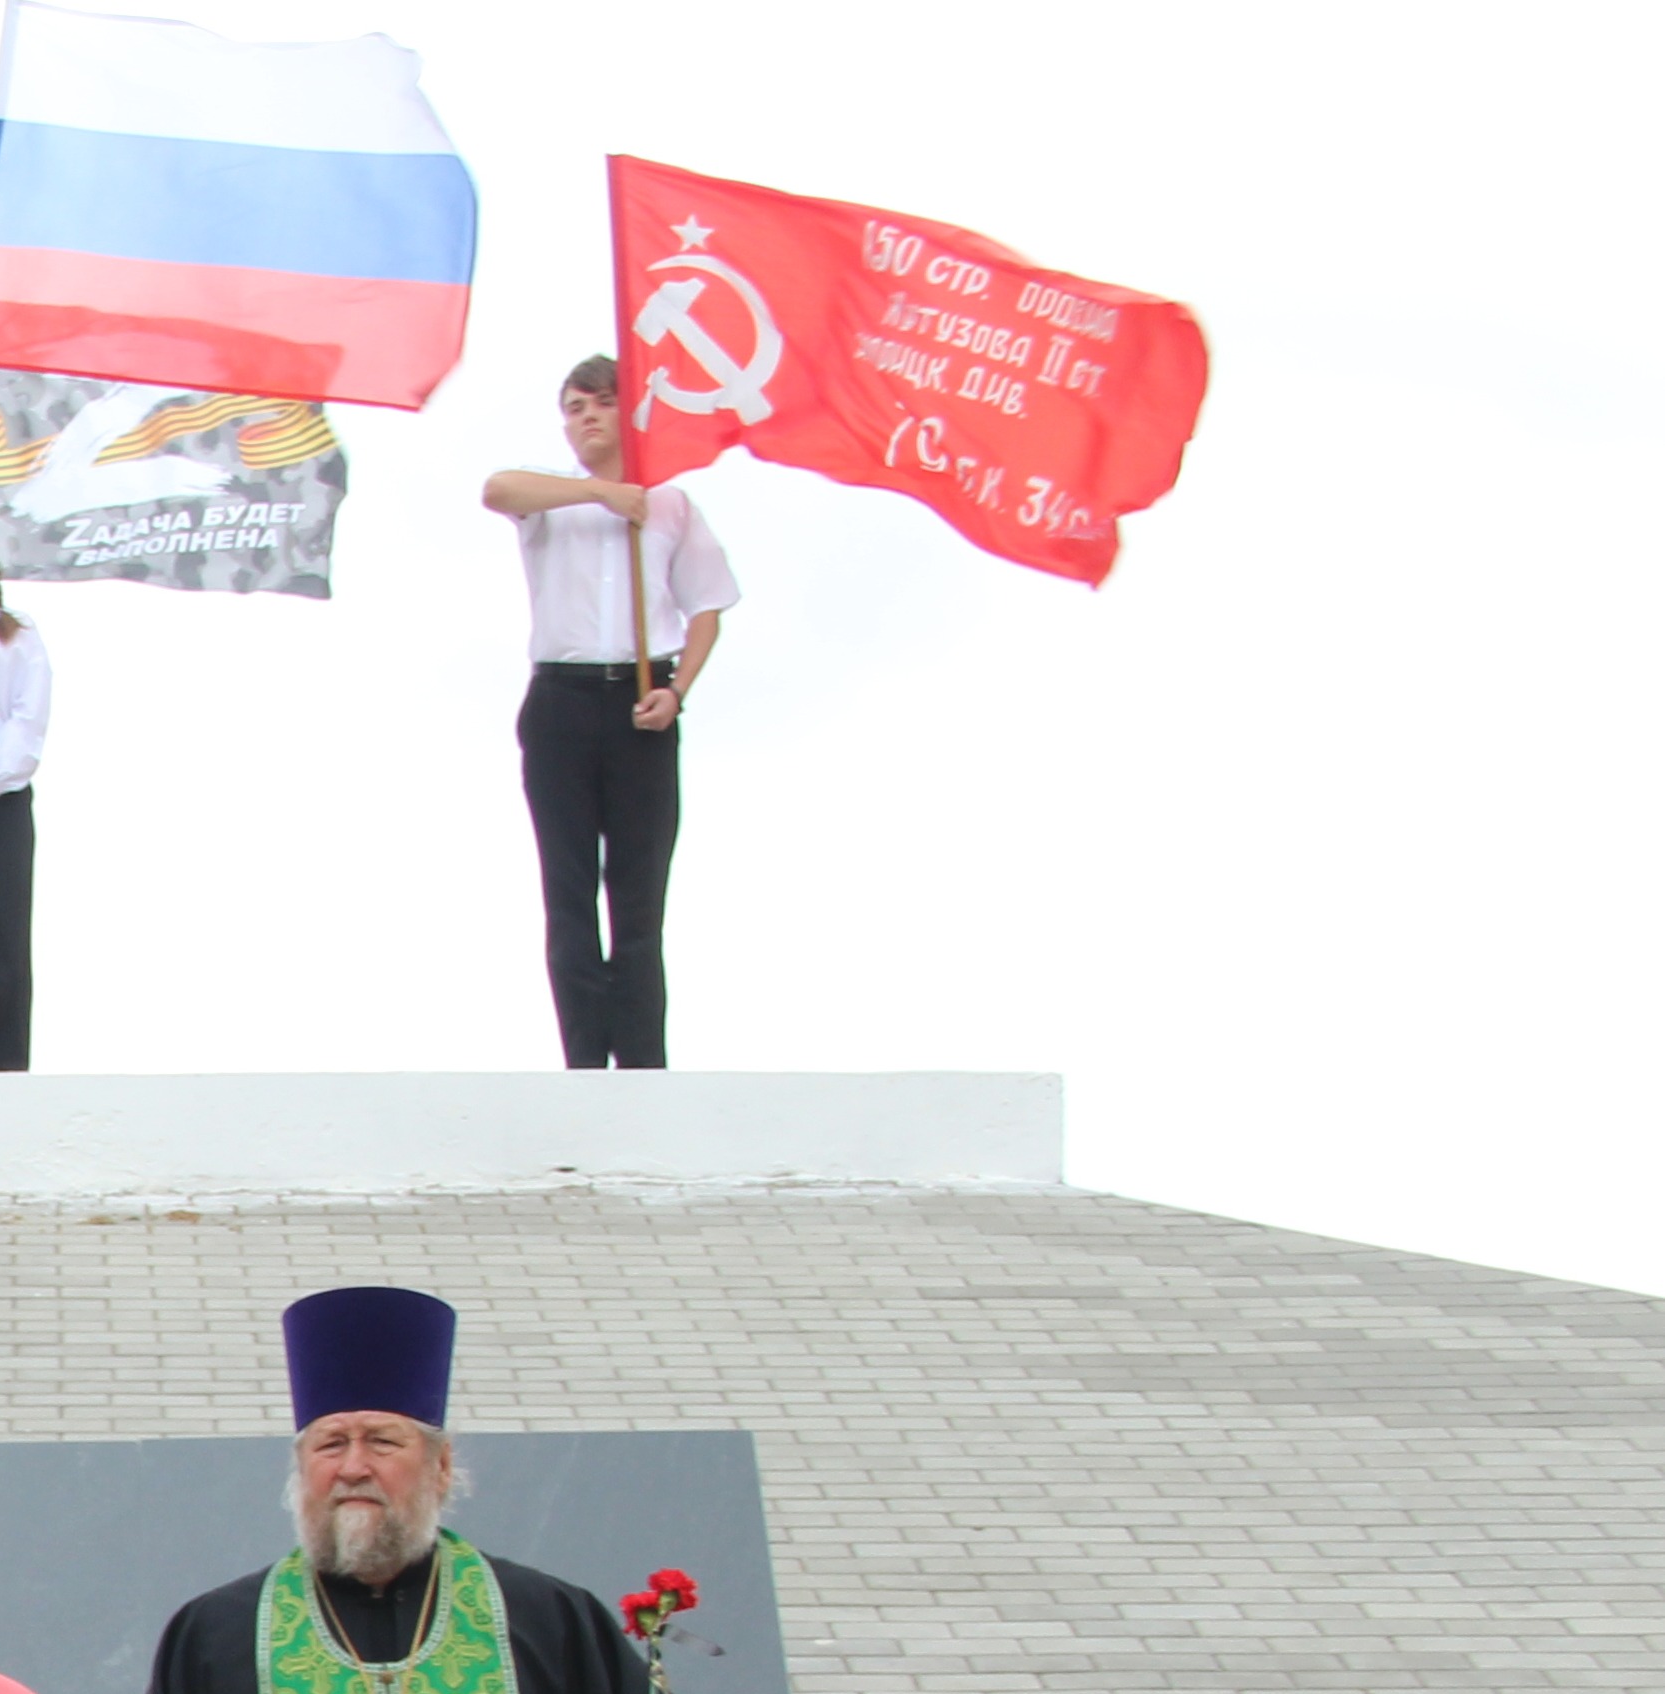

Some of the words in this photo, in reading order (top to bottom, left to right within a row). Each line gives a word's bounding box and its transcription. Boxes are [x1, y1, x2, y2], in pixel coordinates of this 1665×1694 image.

[862, 220, 924, 277] 150
[202, 503, 307, 527] БУДЕТ
[74, 528, 280, 566] ВЫПОЛНЕНА
